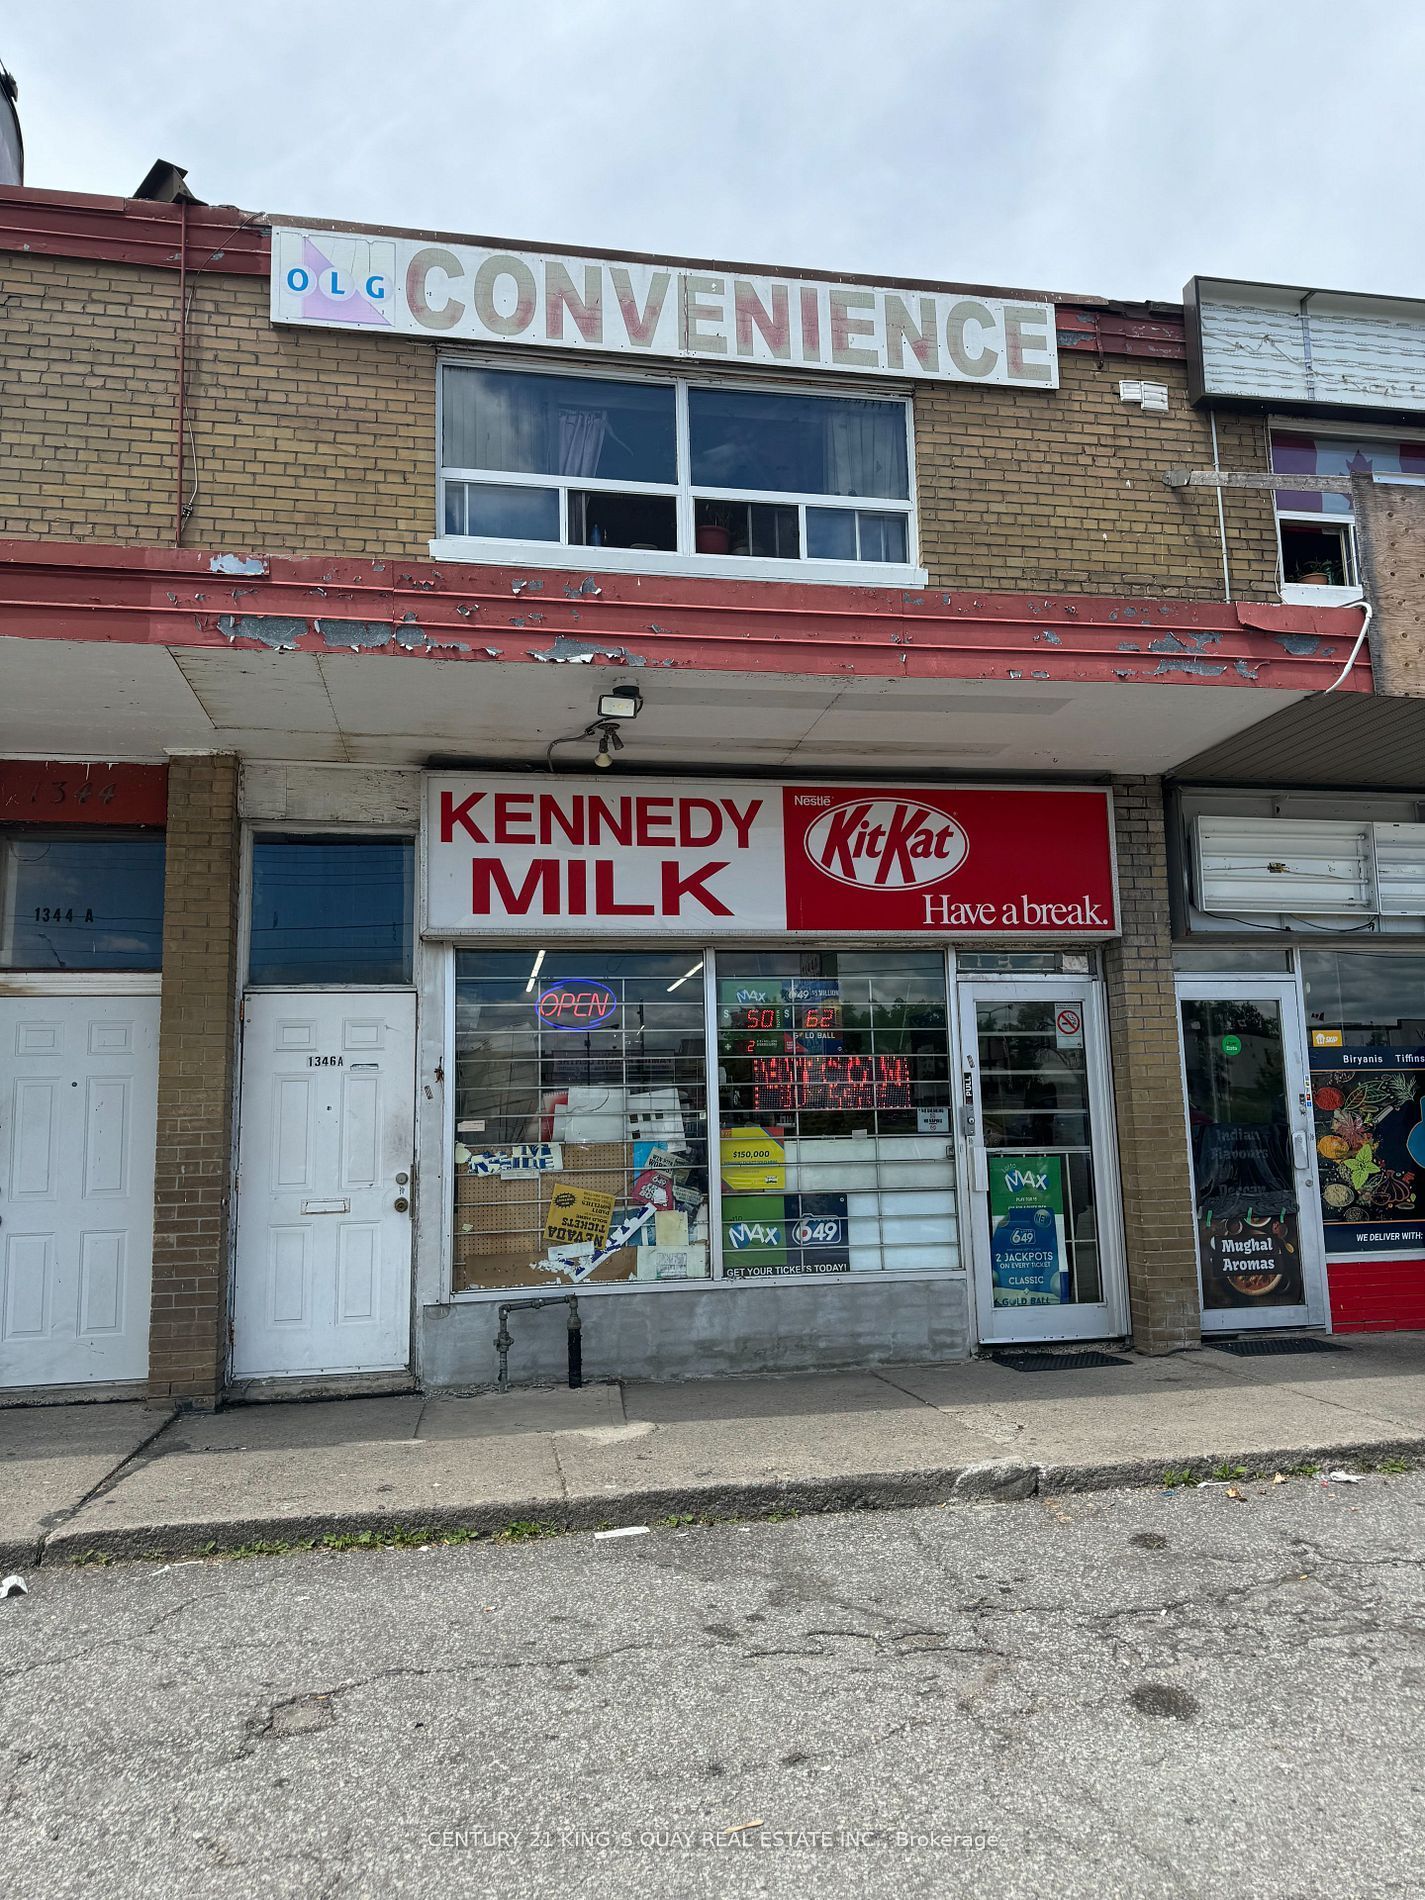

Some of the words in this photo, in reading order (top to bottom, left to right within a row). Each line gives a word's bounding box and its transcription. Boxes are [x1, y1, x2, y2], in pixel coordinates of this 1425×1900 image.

[406, 247, 1051, 382] CONVENIENCE
[31, 780, 117, 805] 1344
[440, 791, 764, 849] KENNEDY
[820, 804, 954, 885] KitKat
[472, 857, 735, 916] MILK
[34, 907, 73, 922] 1344
[84, 908, 94, 922] A
[922, 894, 997, 925] Have
[1001, 903, 1020, 925] a
[1021, 894, 1109, 925] break.
[540, 993, 609, 1017] OPEN
[736, 989, 766, 1003] MAX
[746, 1009, 774, 1028] 50
[805, 1009, 834, 1028] 62
[817, 1031, 836, 1039] BALL
[308, 1056, 344, 1067] 1346A
[1342, 1054, 1383, 1065] Biryanis
[1394, 1053, 1425, 1063] Tiffins
[965, 1076, 973, 1097] PULL
[732, 1150, 770, 1159] $150,000
[1005, 1169, 1047, 1192] MAX
[561, 1217, 606, 1234] TICKETS
[547, 1225, 605, 1248] NEVADA
[728, 1222, 778, 1249] MAX
[1356, 1233, 1369, 1242] WE
[1369, 1232, 1400, 1242] DELIVER
[1401, 1231, 1424, 1240] WITH:
[1221, 1237, 1273, 1255] Mughal
[995, 1253, 1001, 1262] 2
[1004, 1251, 1054, 1262] JACKPOTS
[1222, 1258, 1275, 1271] Aromas
[726, 1267, 746, 1277] GET
[747, 1266, 773, 1276] YOUR
[813, 1263, 847, 1273] TODAY!
[1008, 1276, 1044, 1285] CLASSIC
[1030, 1296, 1050, 1305] BALL
